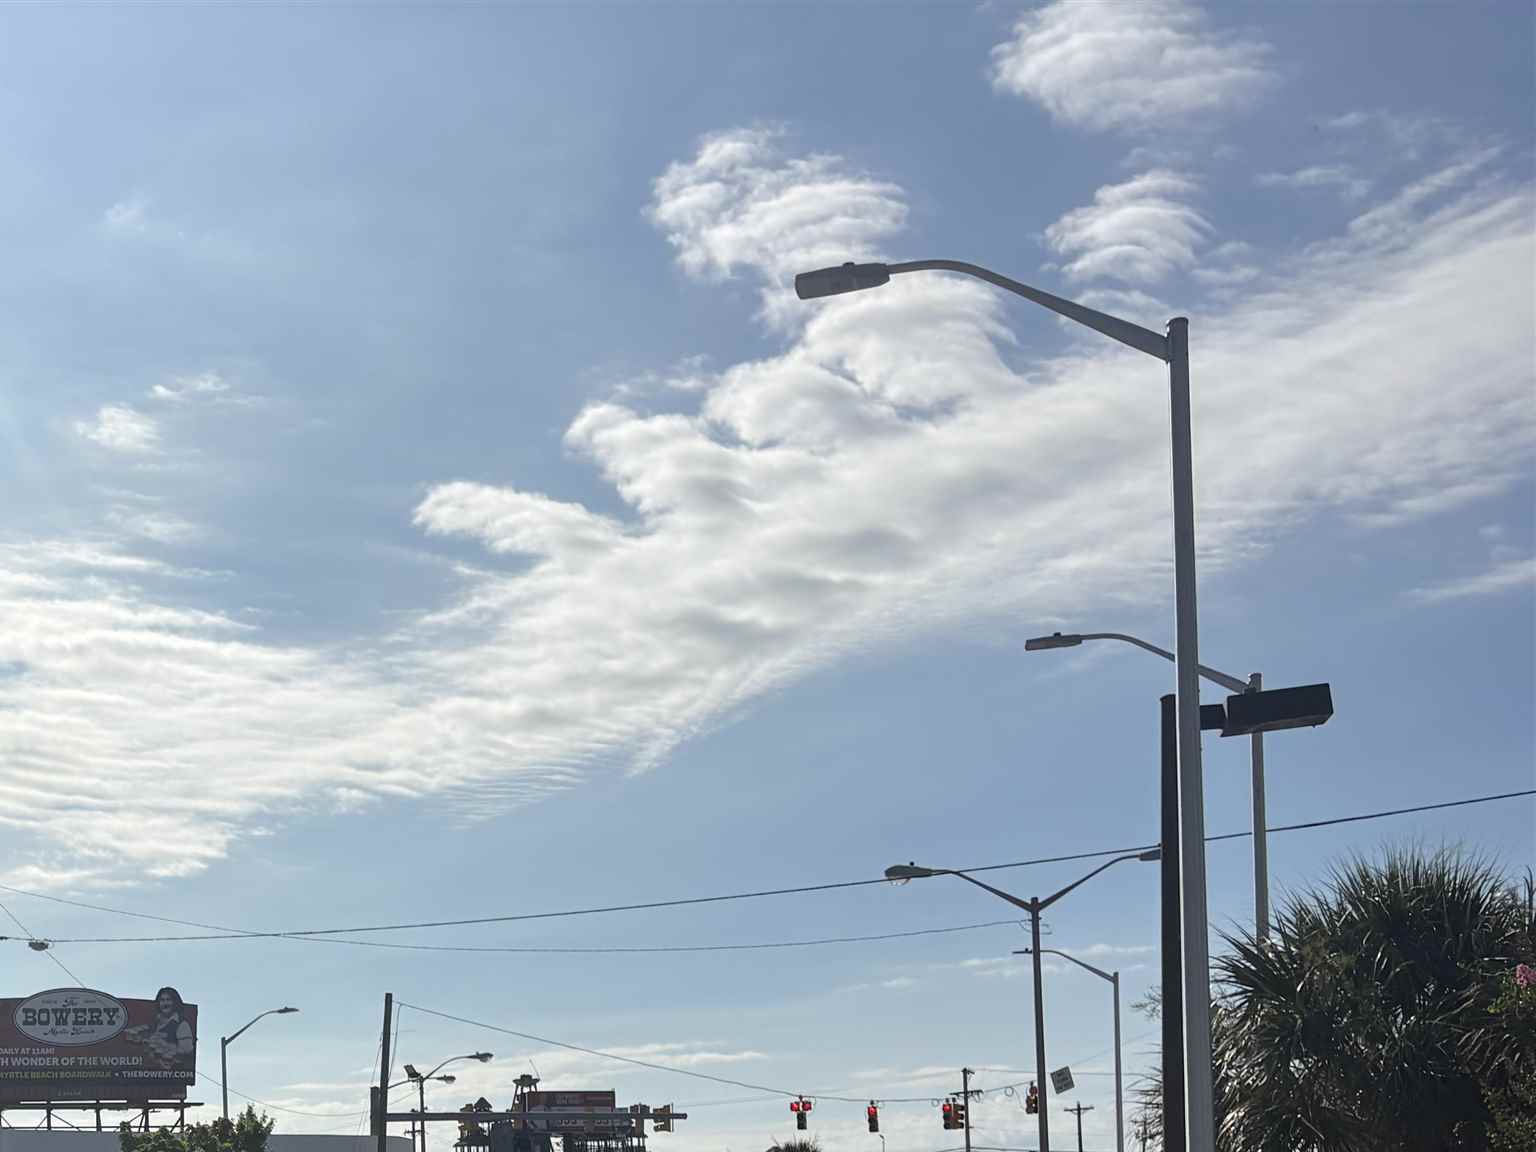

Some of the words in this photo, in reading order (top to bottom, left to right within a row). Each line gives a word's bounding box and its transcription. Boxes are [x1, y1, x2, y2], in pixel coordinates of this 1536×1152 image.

[22, 1008, 119, 1025] BOWERY
[10, 1057, 60, 1066] WONDER
[61, 1056, 76, 1066] OF
[78, 1056, 98, 1066] THE
[99, 1056, 143, 1066] WORLD!
[122, 1071, 194, 1079] THEBOWERY.COM
